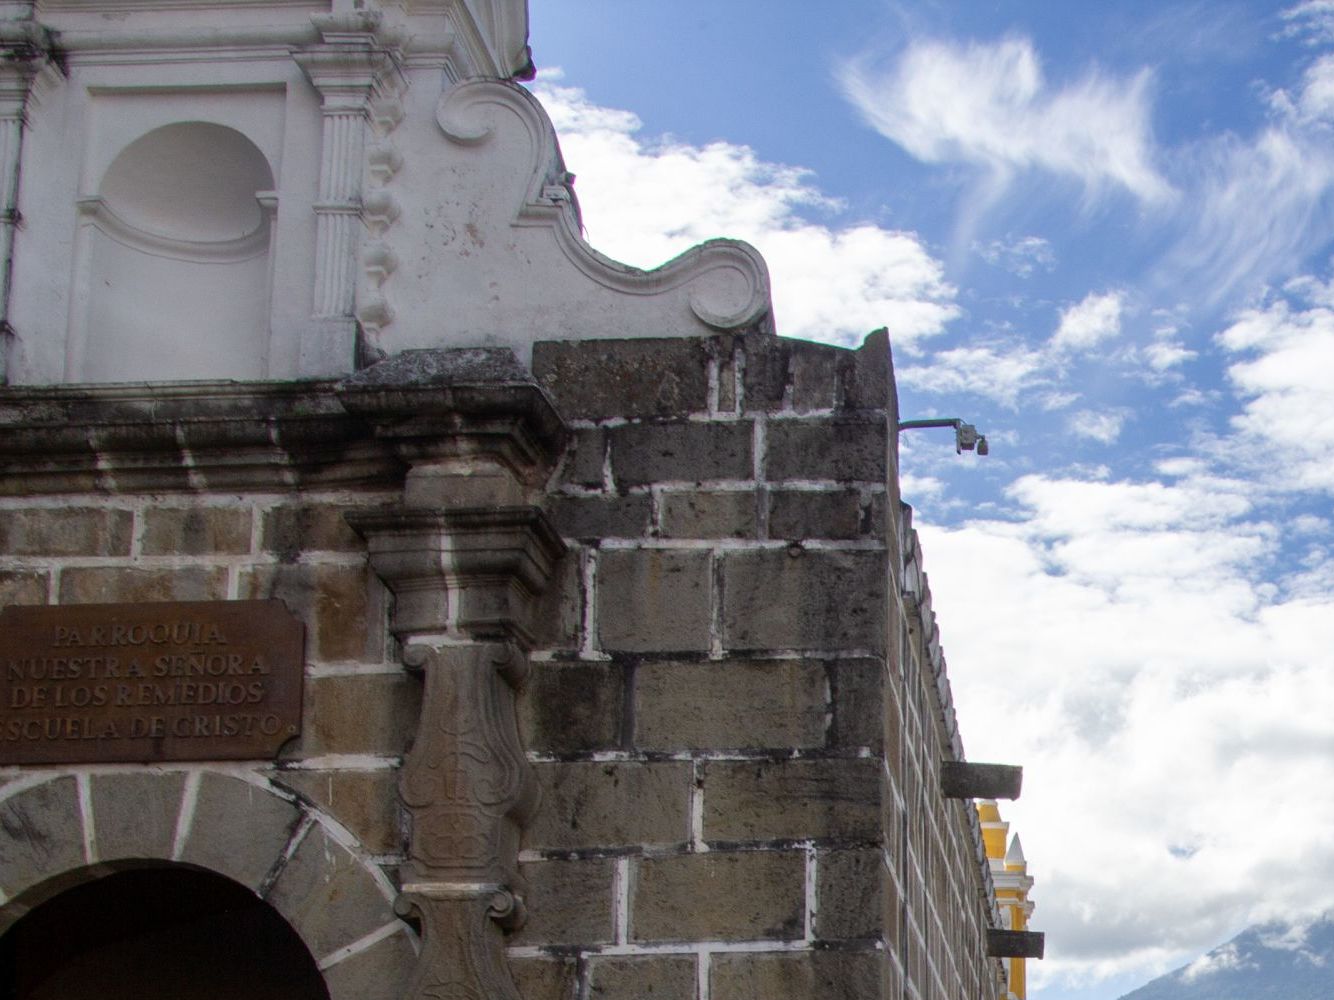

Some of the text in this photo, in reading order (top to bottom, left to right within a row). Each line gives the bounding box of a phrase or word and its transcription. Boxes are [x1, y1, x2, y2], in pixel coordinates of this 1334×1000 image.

[52, 622, 228, 647] PARROQUIA
[7, 650, 270, 681] NUESTRA SEÑORA
[10, 681, 265, 710] DE LOS REMEDIOS
[129, 715, 166, 740] DE
[172, 713, 282, 739] CRISTO
